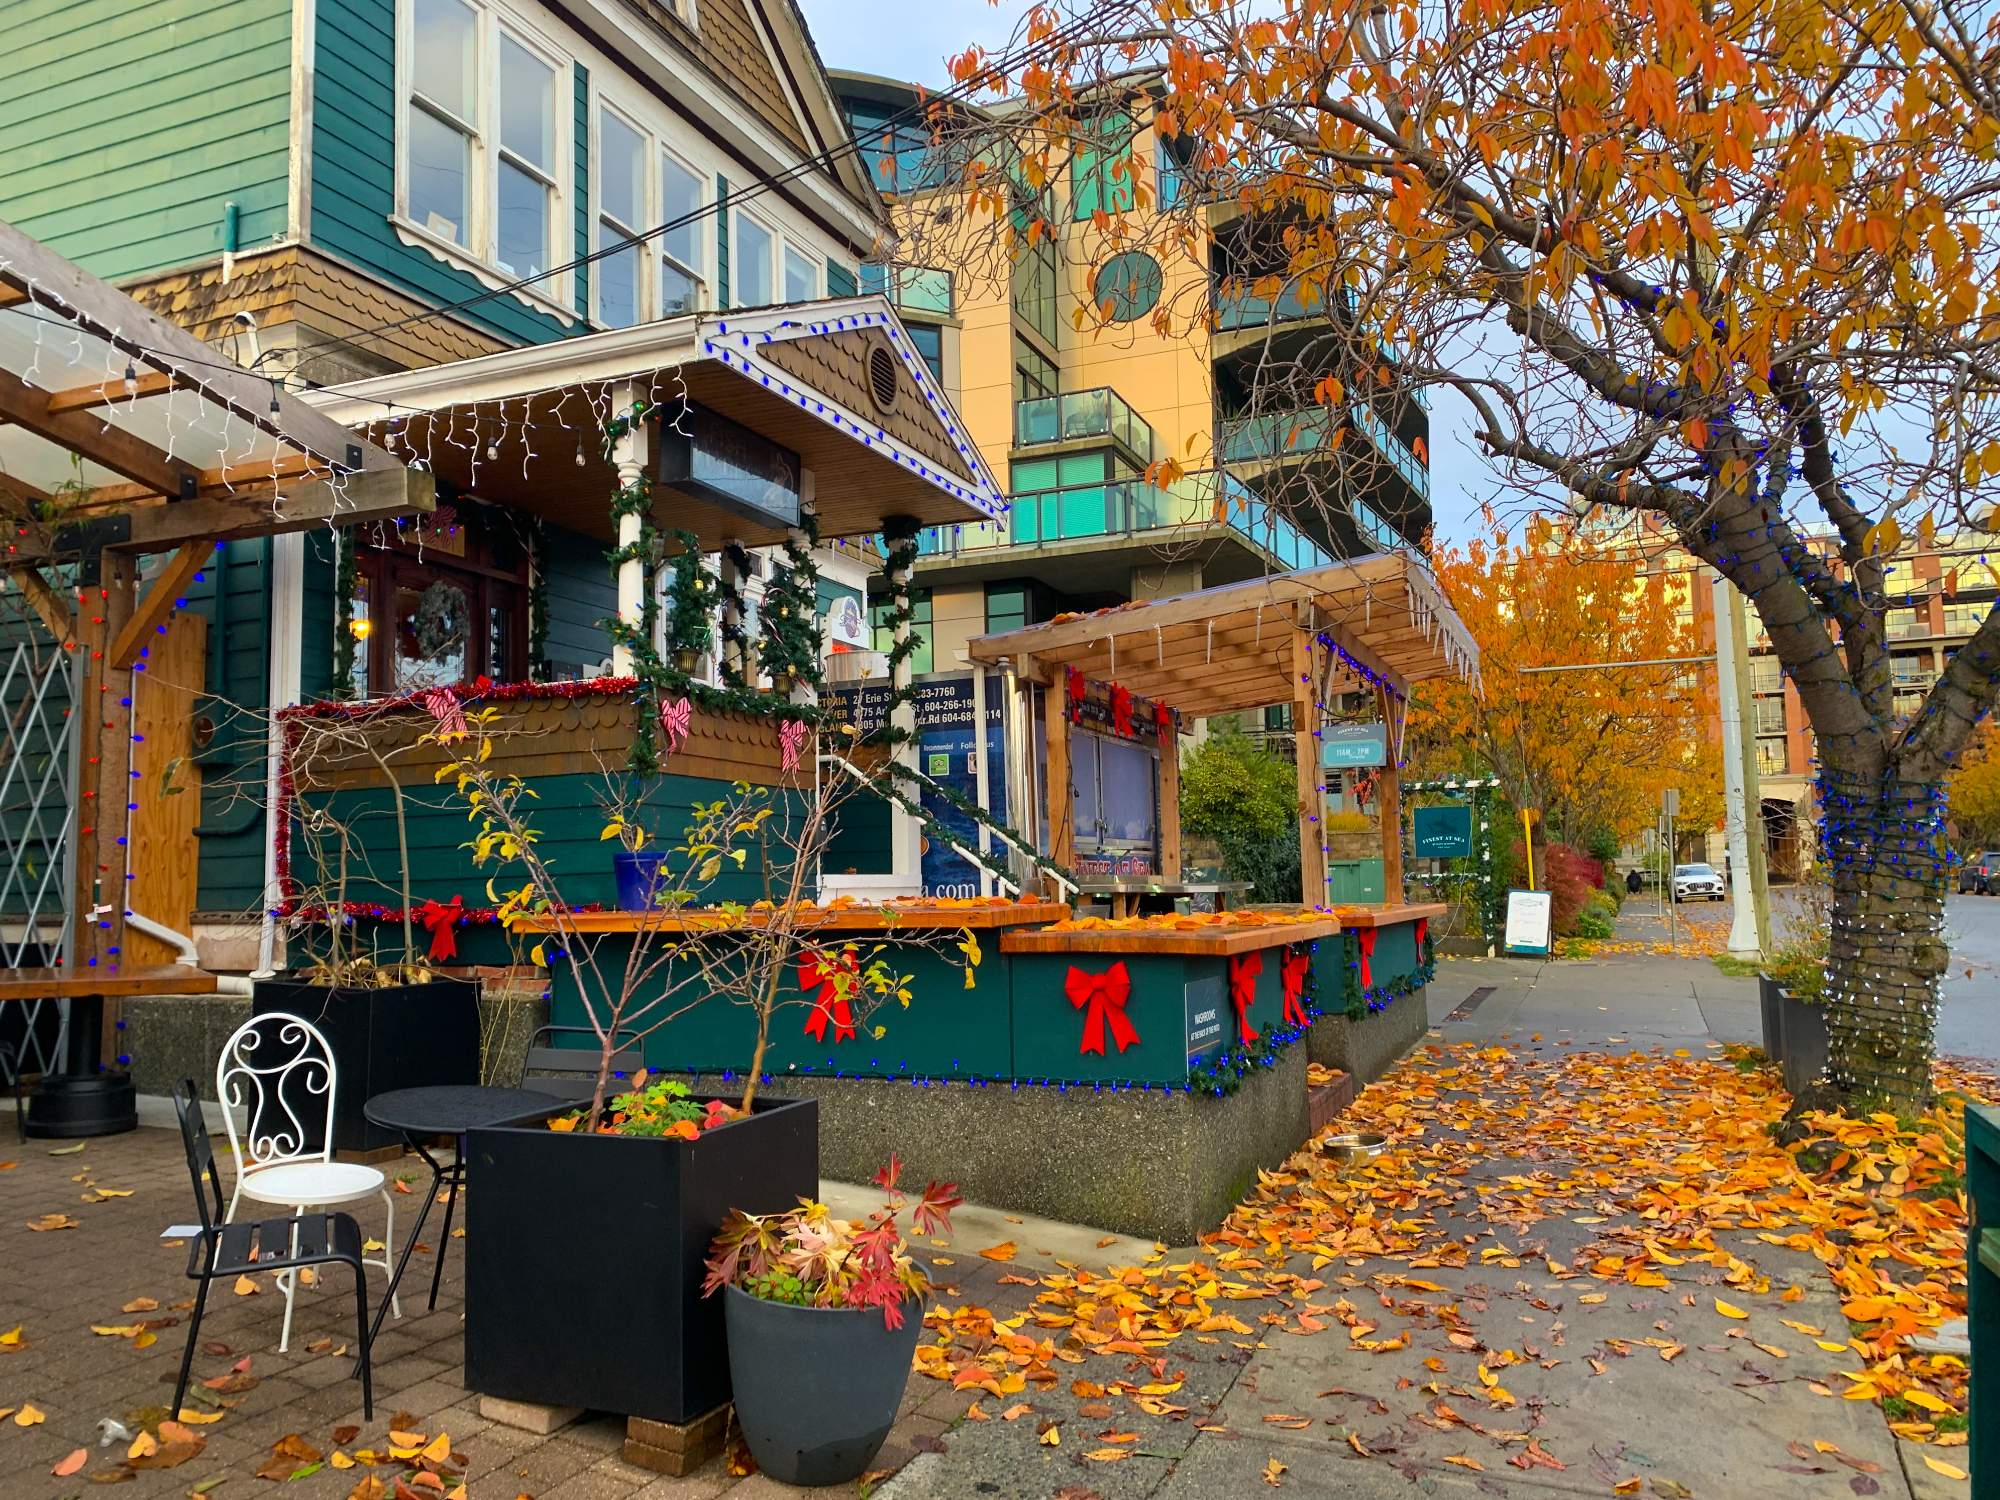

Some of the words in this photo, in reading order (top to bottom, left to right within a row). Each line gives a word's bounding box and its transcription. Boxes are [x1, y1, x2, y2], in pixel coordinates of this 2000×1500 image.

[865, 693, 882, 704] Erie
[924, 699, 976, 712] 604-266-190
[923, 742, 954, 752] Recommended
[960, 741, 977, 750] Follo
[1336, 748, 1351, 757] 11AM
[1422, 836, 1443, 845] FINEST
